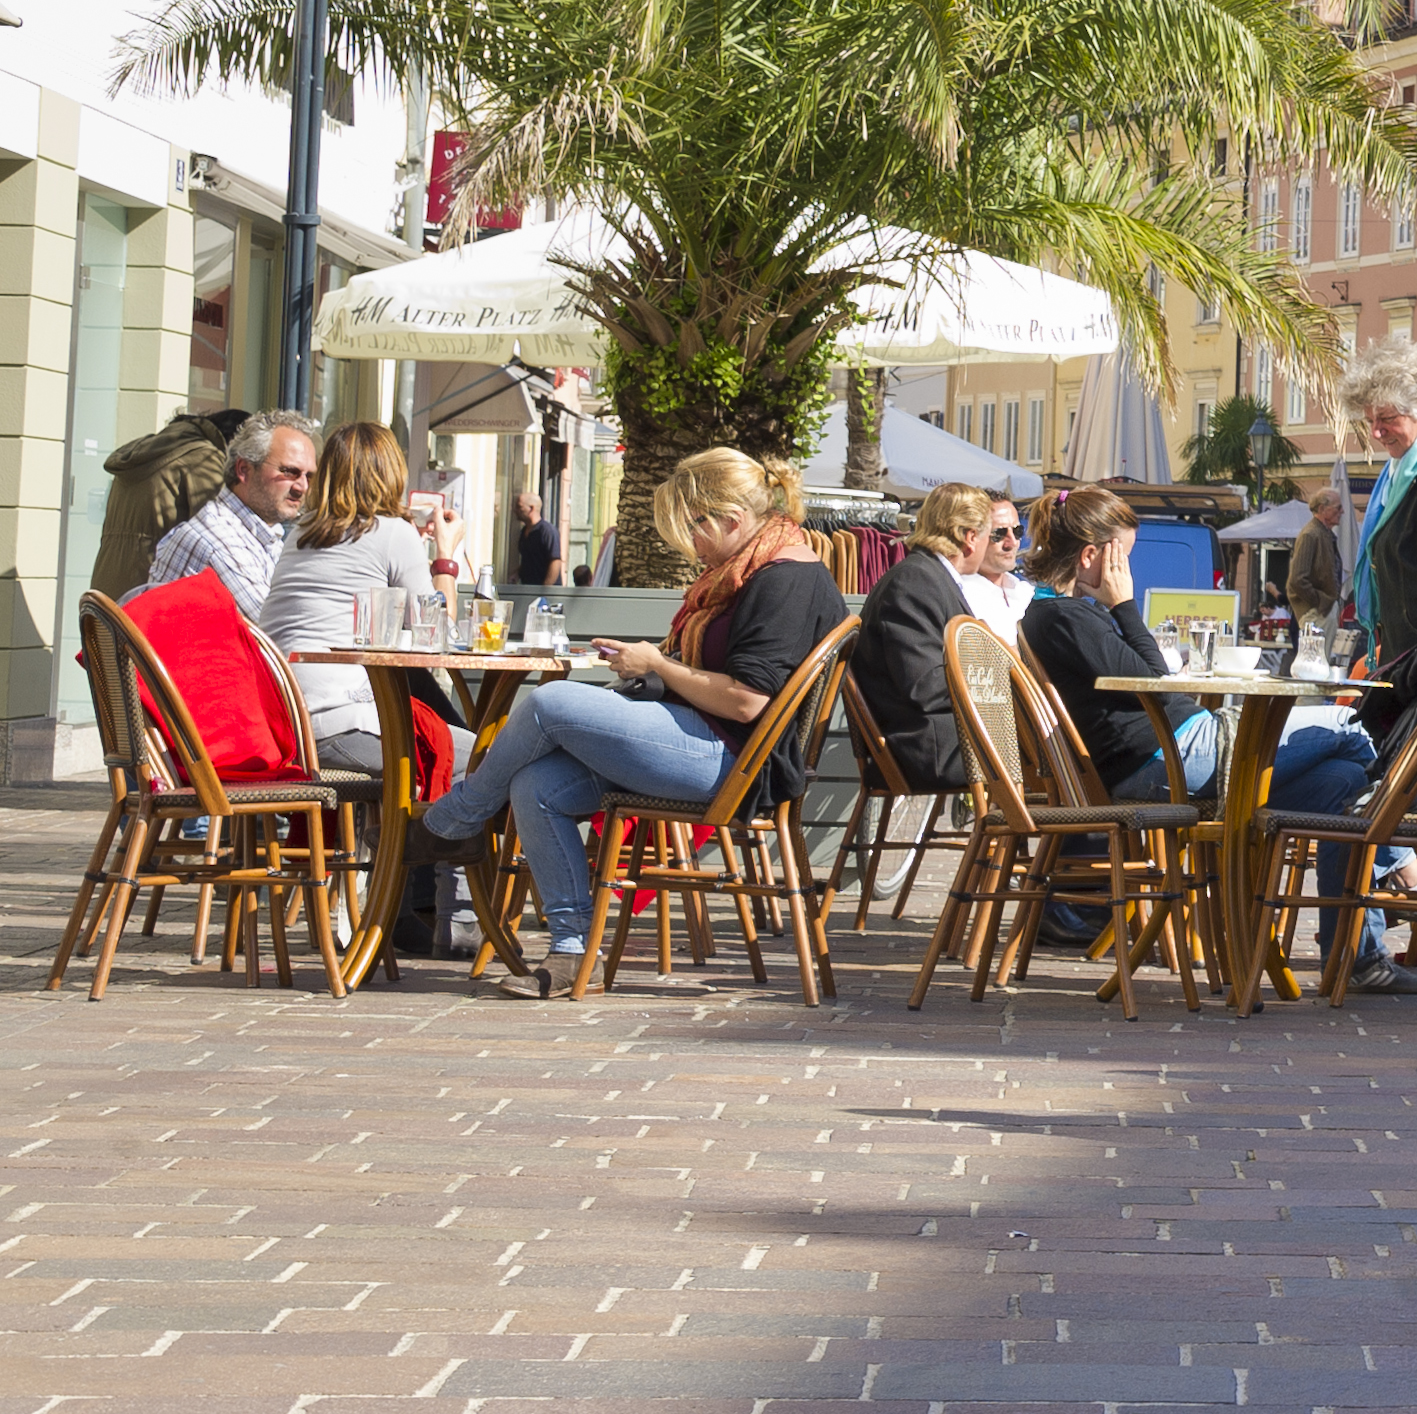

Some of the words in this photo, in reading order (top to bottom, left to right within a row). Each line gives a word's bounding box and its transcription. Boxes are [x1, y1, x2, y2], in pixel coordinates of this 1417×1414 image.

[350, 296, 394, 326] H&M
[389, 304, 467, 329] ALTER
[475, 306, 543, 328] PLATZ
